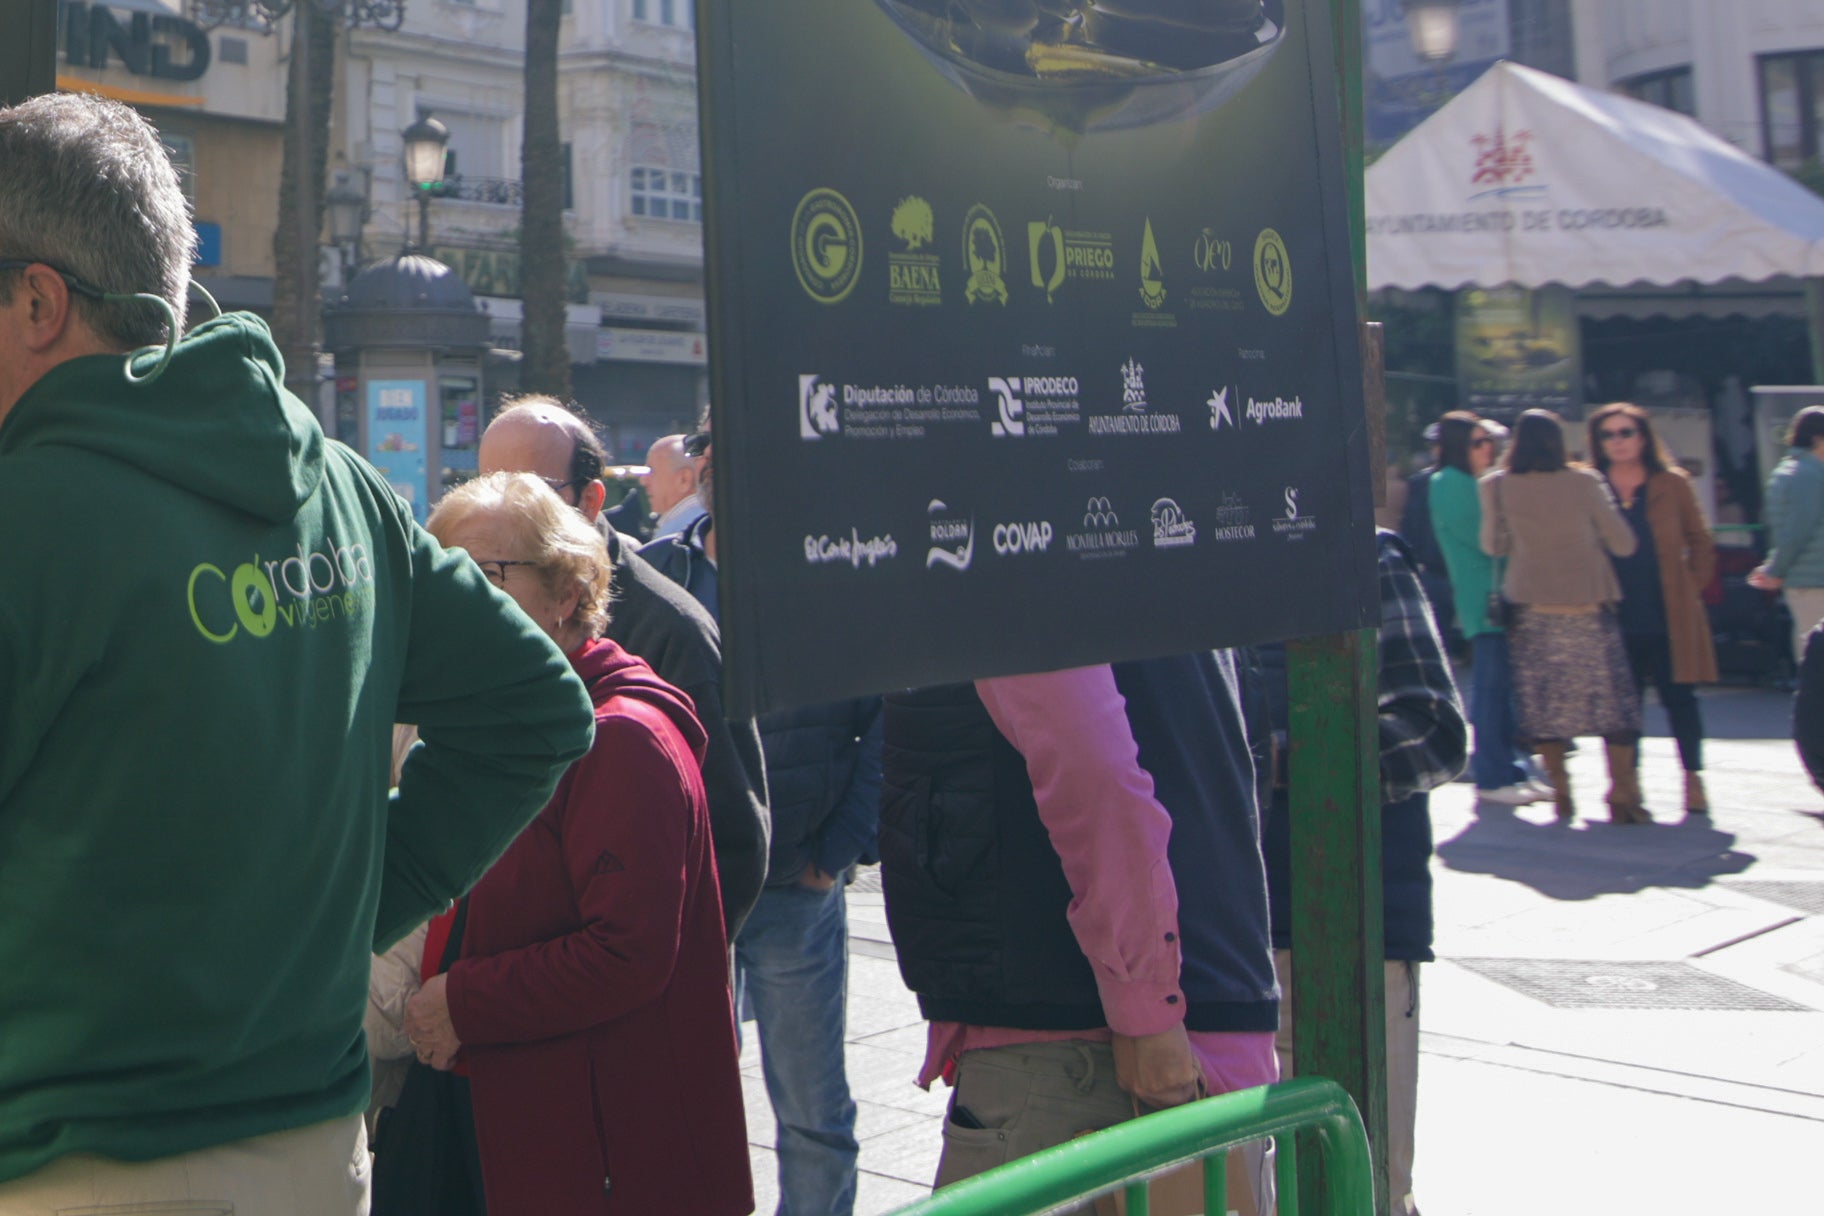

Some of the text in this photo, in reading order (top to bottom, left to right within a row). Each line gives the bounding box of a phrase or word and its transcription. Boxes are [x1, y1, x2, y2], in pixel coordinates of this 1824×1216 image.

[1522, 209, 1550, 232] DE
[1559, 204, 1668, 231] CORDOBA
[1066, 246, 1114, 268] PRIEGO
[889, 264, 941, 291] BAENA
[843, 384, 978, 405] Diputación de Córdoba
[1024, 377, 1079, 394] IPRODECO
[1246, 396, 1303, 425] AgroBank
[1088, 415, 1139, 434] AYUNTAMIENTO
[1140, 415, 1149, 433] DE
[993, 521, 1053, 553] COVAP
